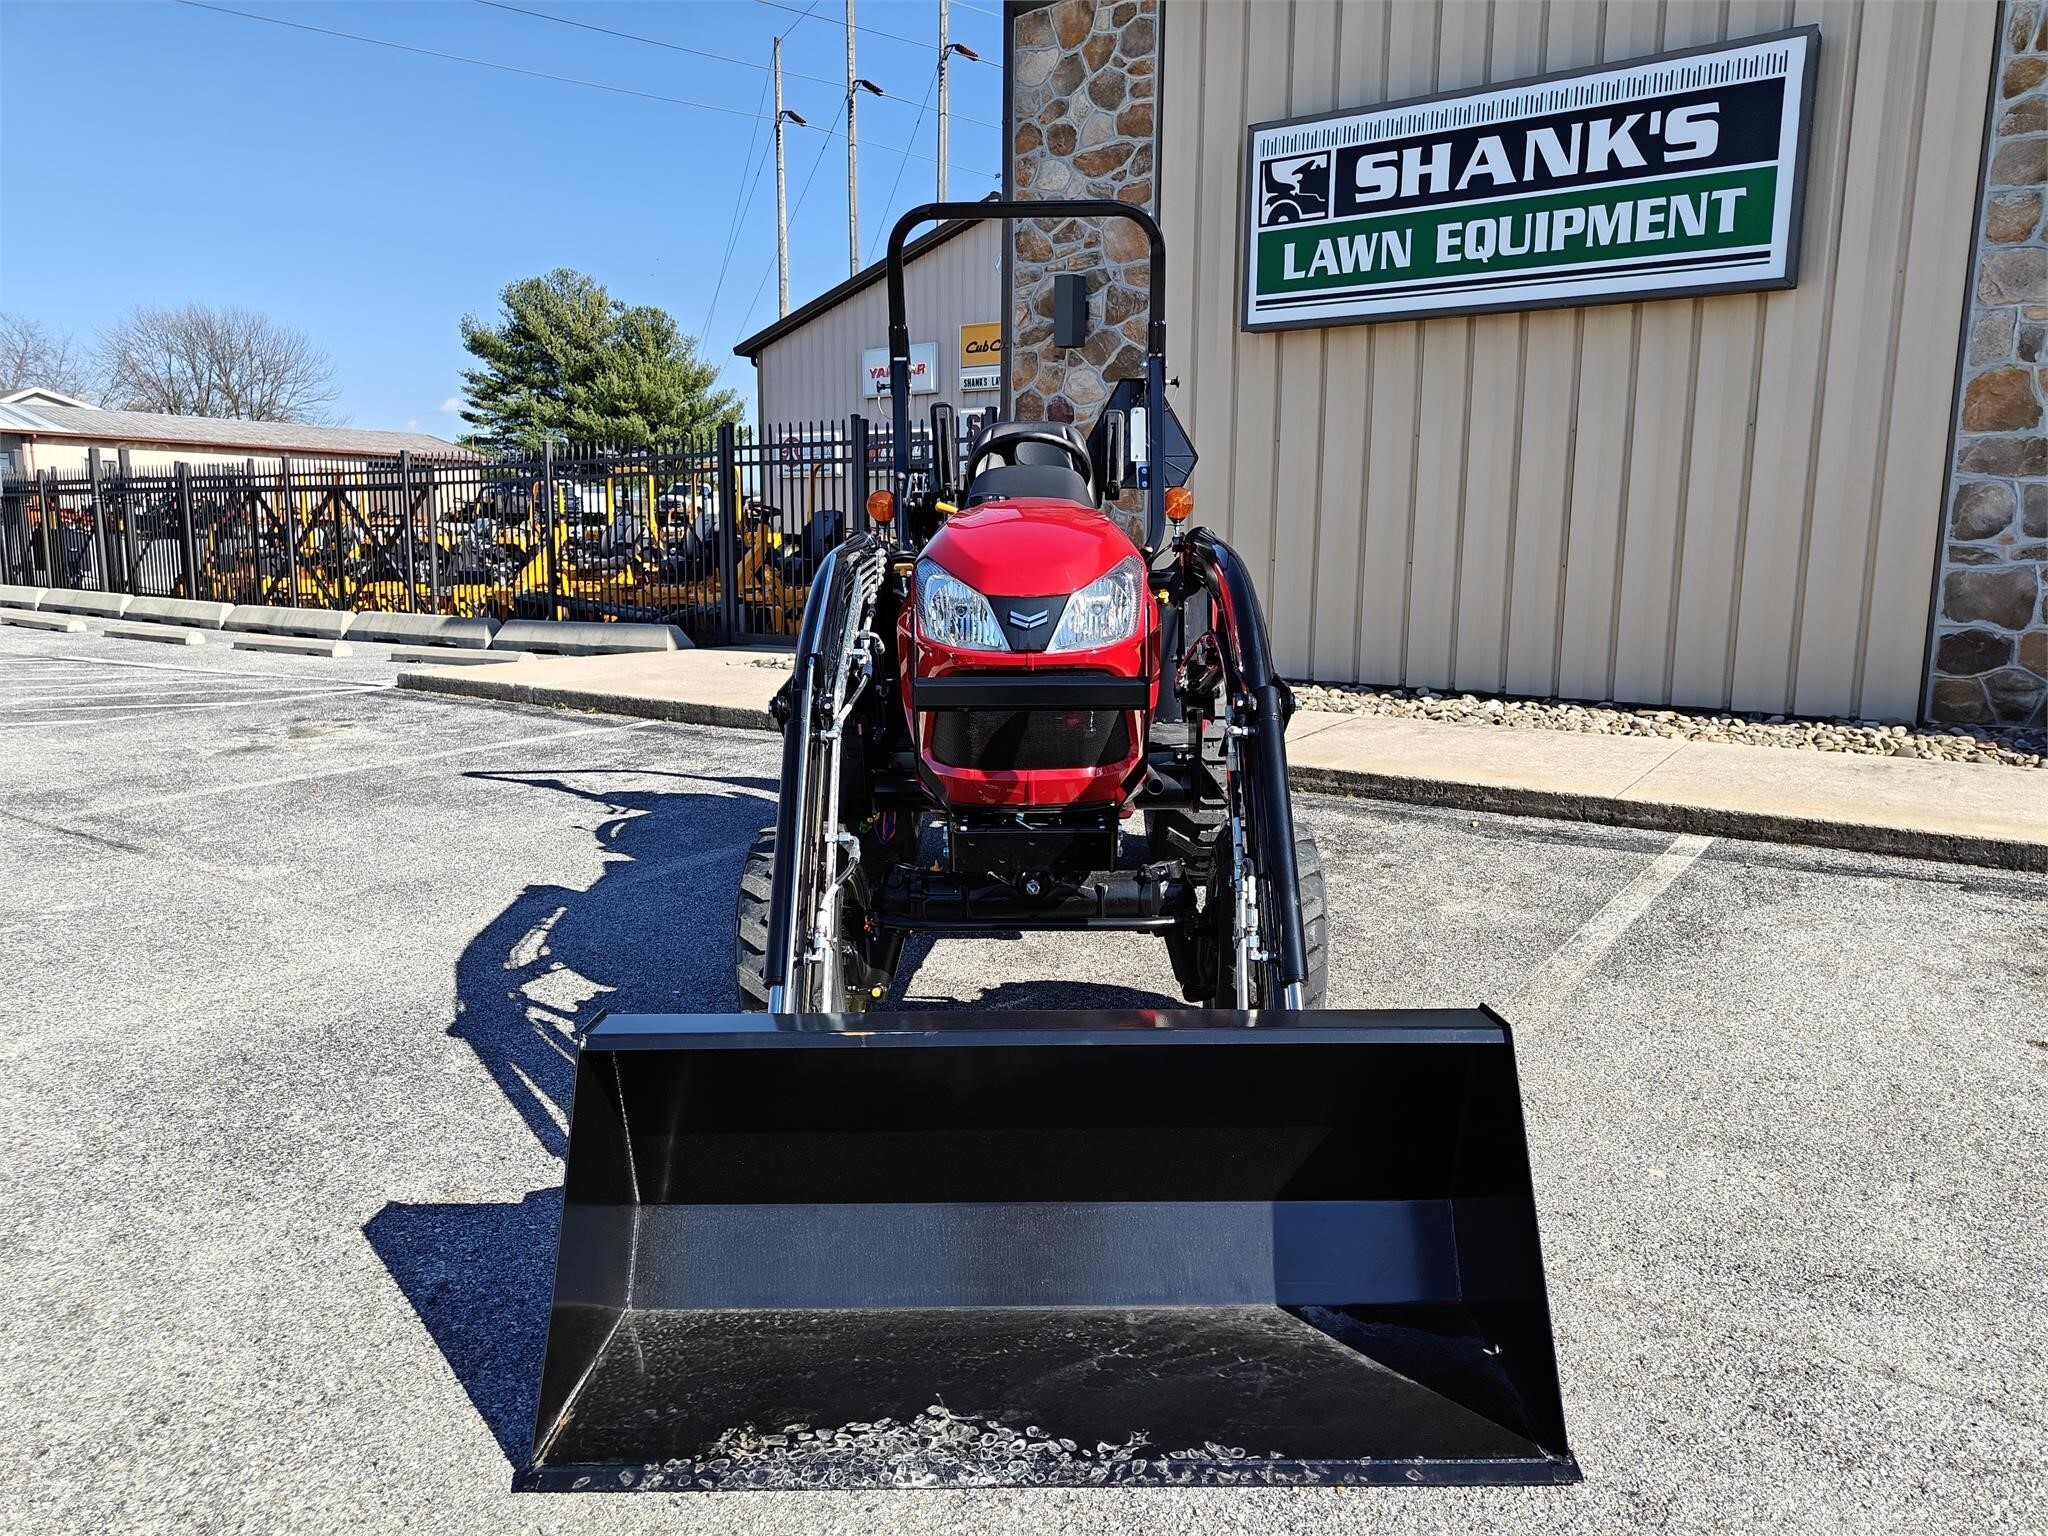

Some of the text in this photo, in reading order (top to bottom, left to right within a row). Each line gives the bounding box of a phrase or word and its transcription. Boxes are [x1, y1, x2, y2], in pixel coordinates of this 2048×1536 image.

[1355, 101, 1720, 203] SHANK'S
[1283, 186, 1747, 281] LAWN EQUIPMENT
[966, 340, 989, 353] Cub
